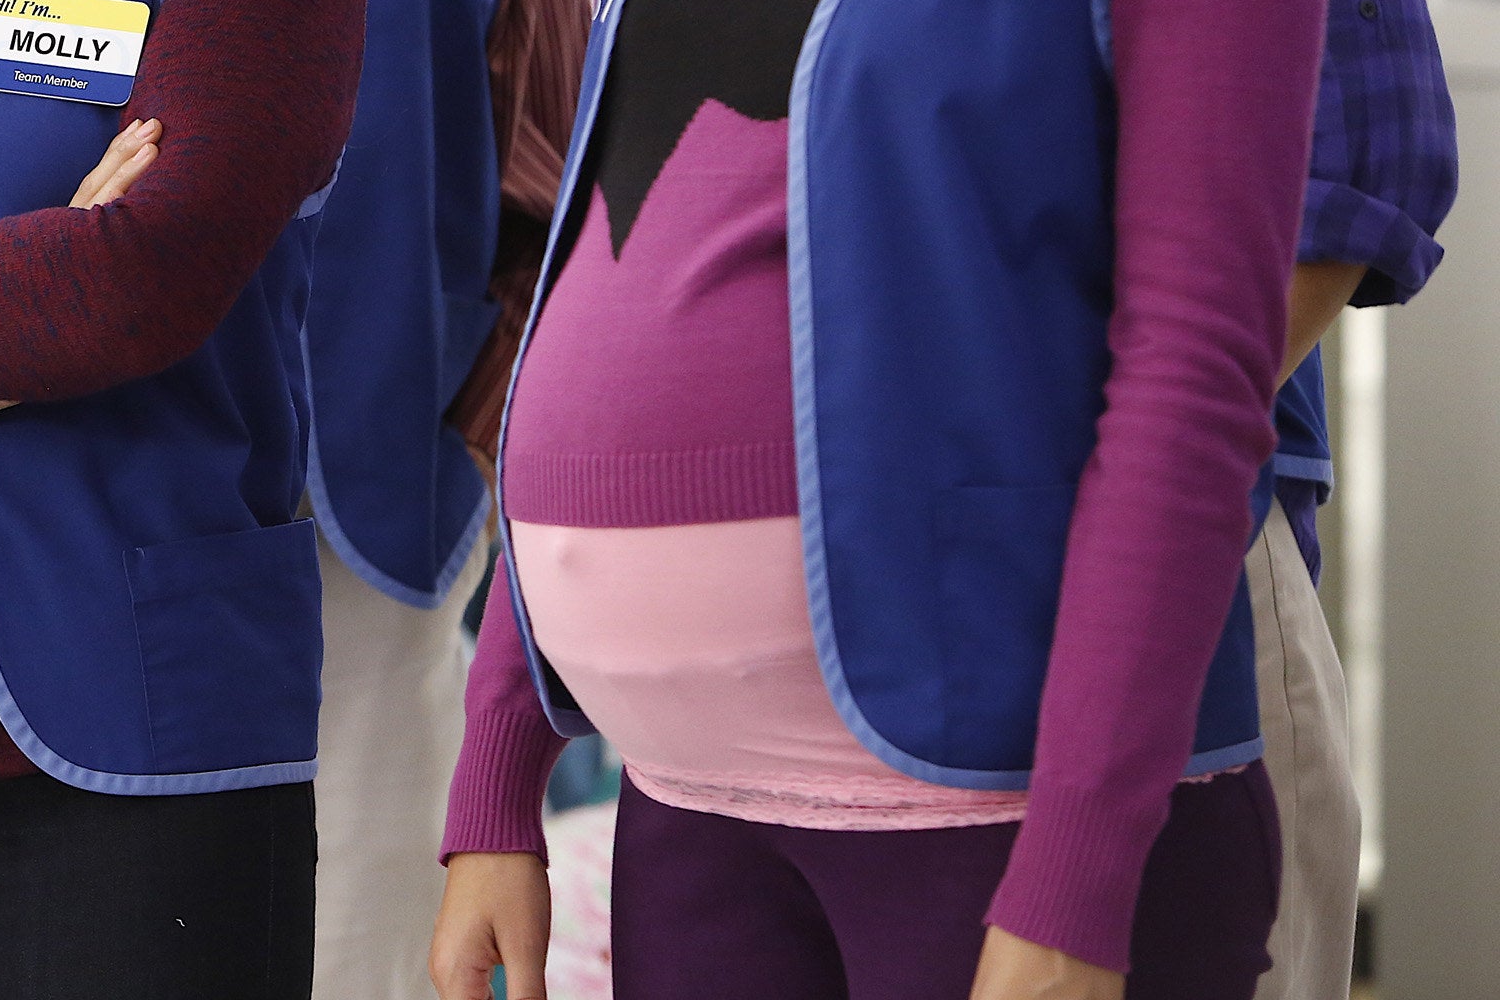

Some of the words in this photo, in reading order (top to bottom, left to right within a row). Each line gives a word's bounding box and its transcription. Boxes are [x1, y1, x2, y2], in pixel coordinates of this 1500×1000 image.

[19, 0, 61, 19] I'm...
[9, 29, 110, 62] MOLLY
[13, 71, 41, 84] Team
[43, 75, 88, 90] Member
